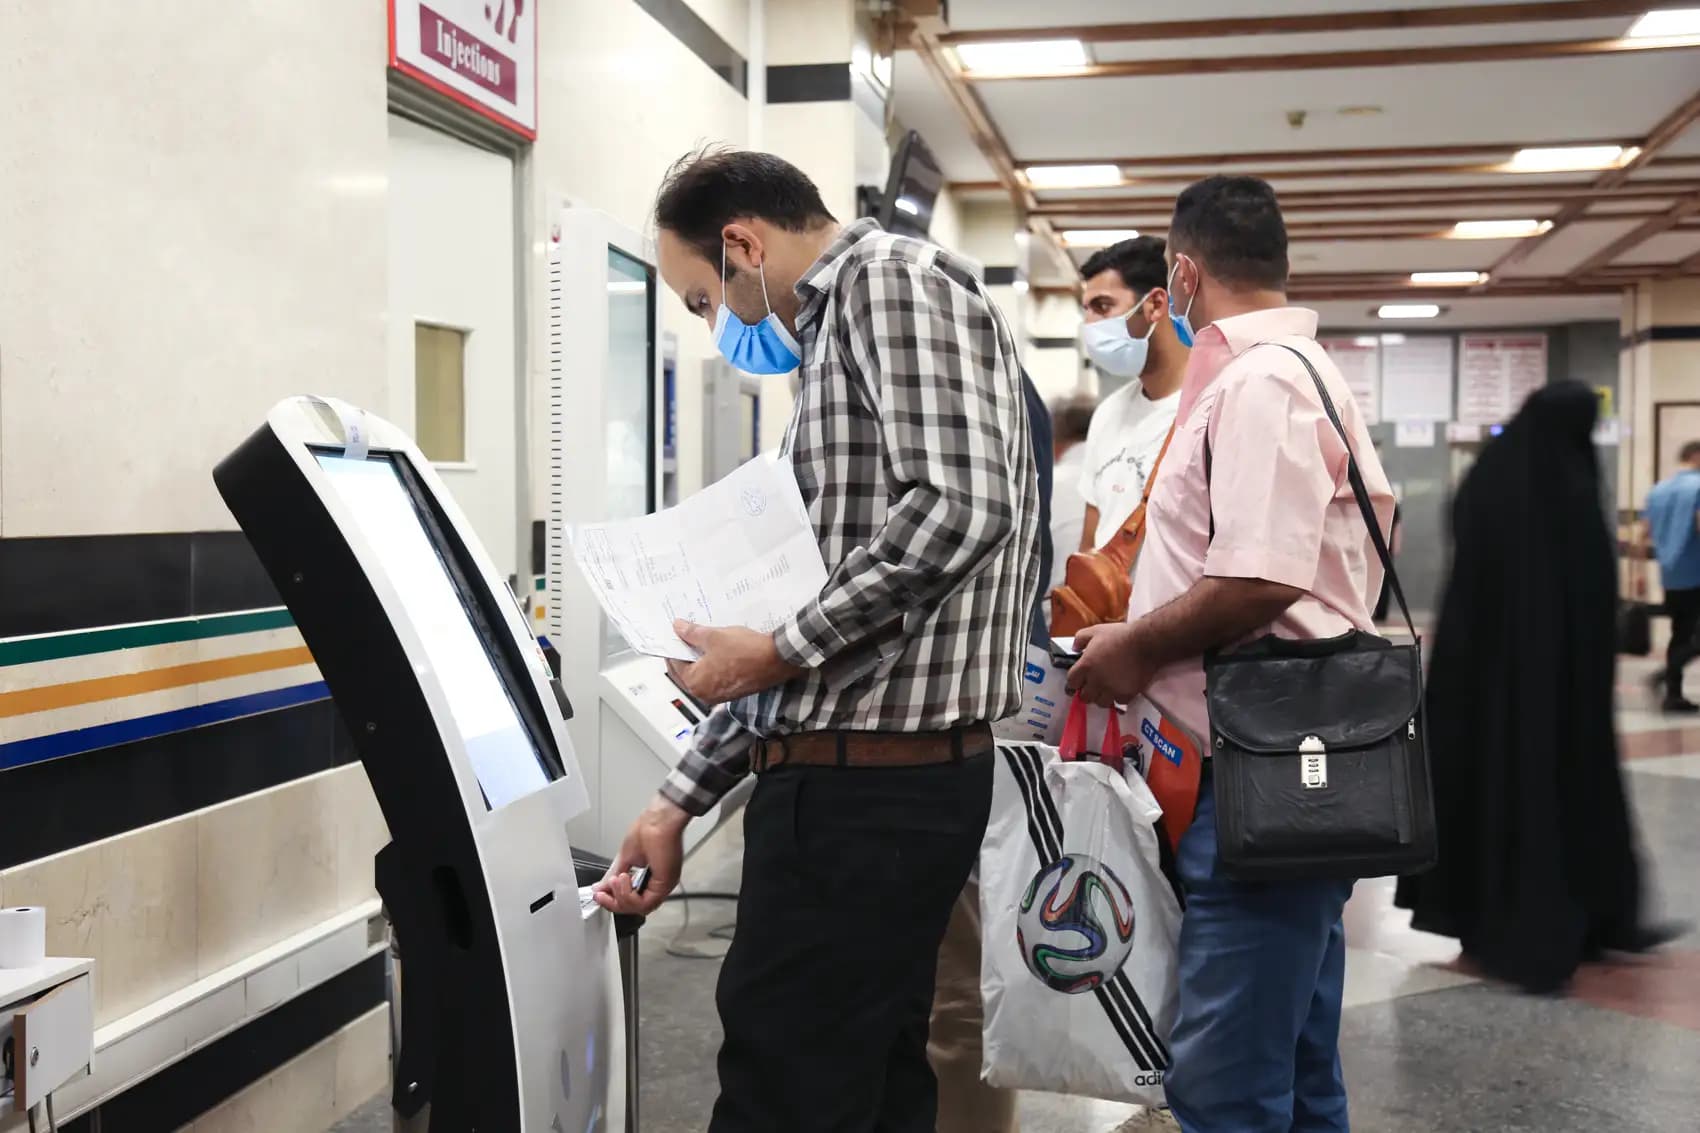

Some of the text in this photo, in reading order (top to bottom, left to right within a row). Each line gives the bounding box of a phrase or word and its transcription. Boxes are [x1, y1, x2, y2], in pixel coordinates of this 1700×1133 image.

[436, 19, 500, 86] Injections
[1144, 723, 1176, 759] CT SCAN
[1134, 1071, 1164, 1086] adi
